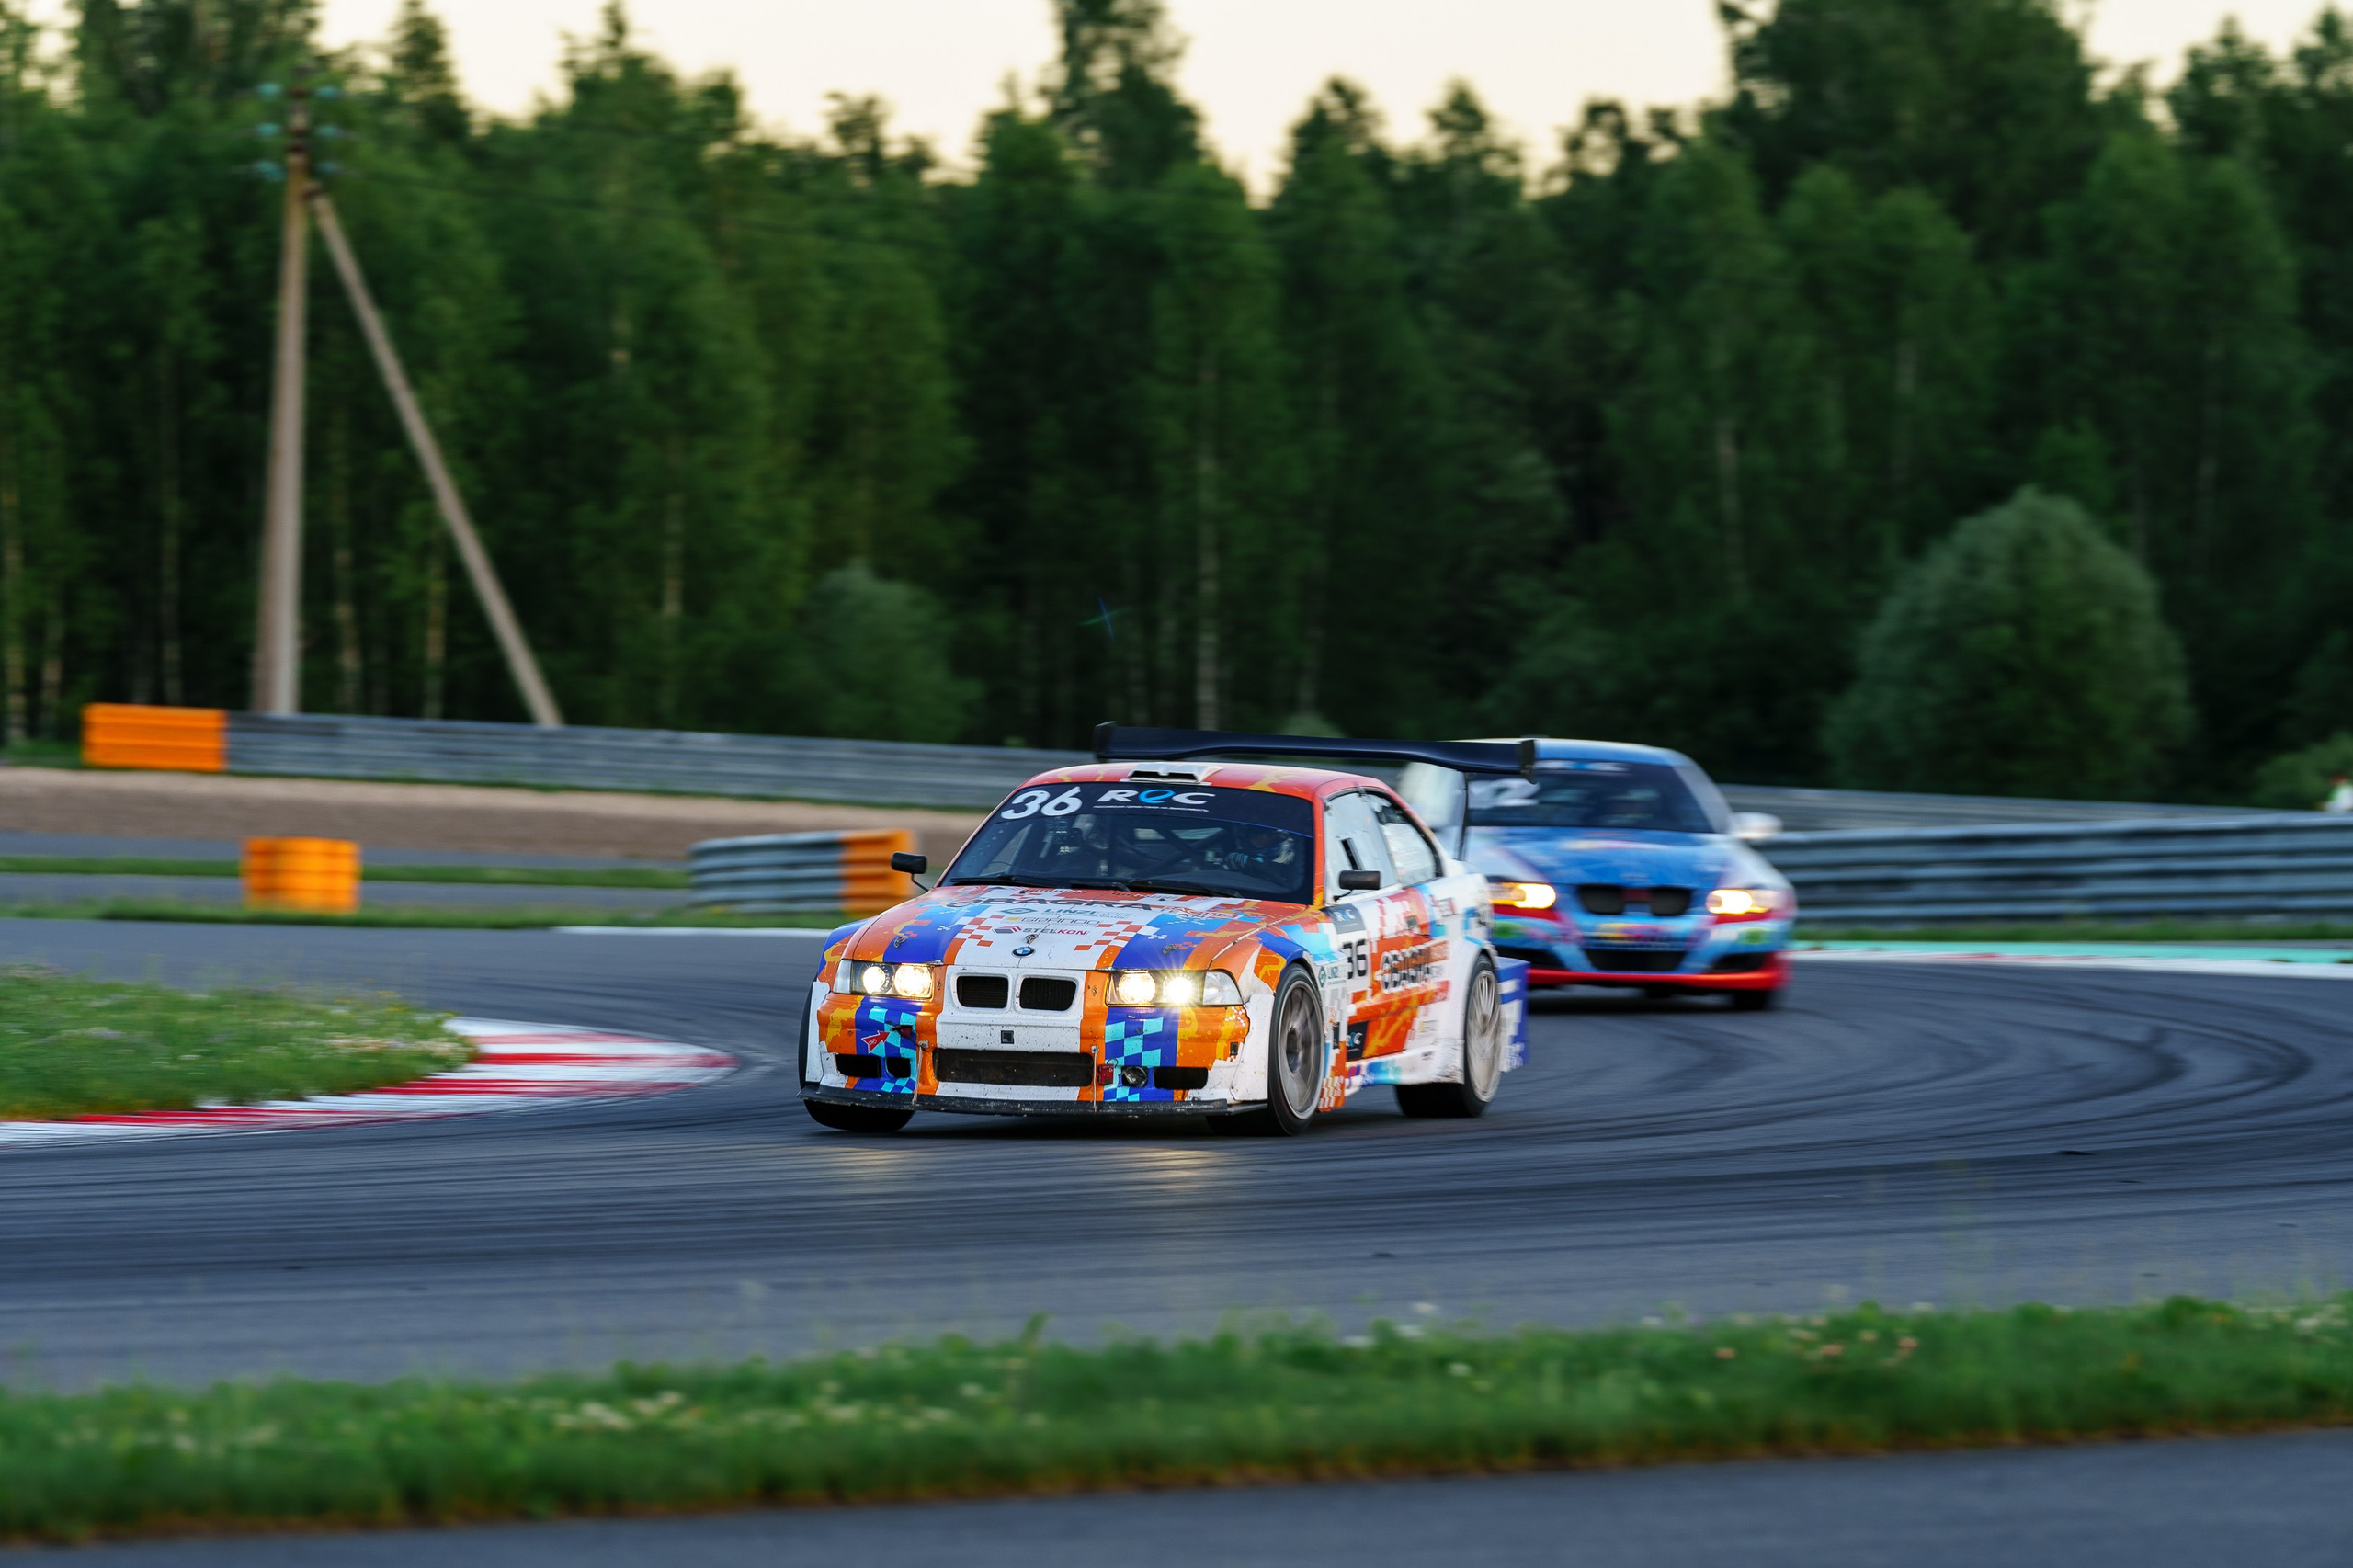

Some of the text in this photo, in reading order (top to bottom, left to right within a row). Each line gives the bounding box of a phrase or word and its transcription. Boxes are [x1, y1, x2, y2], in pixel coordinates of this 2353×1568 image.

[1001, 786, 1083, 819] 36
[947, 898, 1153, 912] OBAGRA
[1022, 927, 1088, 936] STELKON
[1342, 938, 1367, 980] 36
